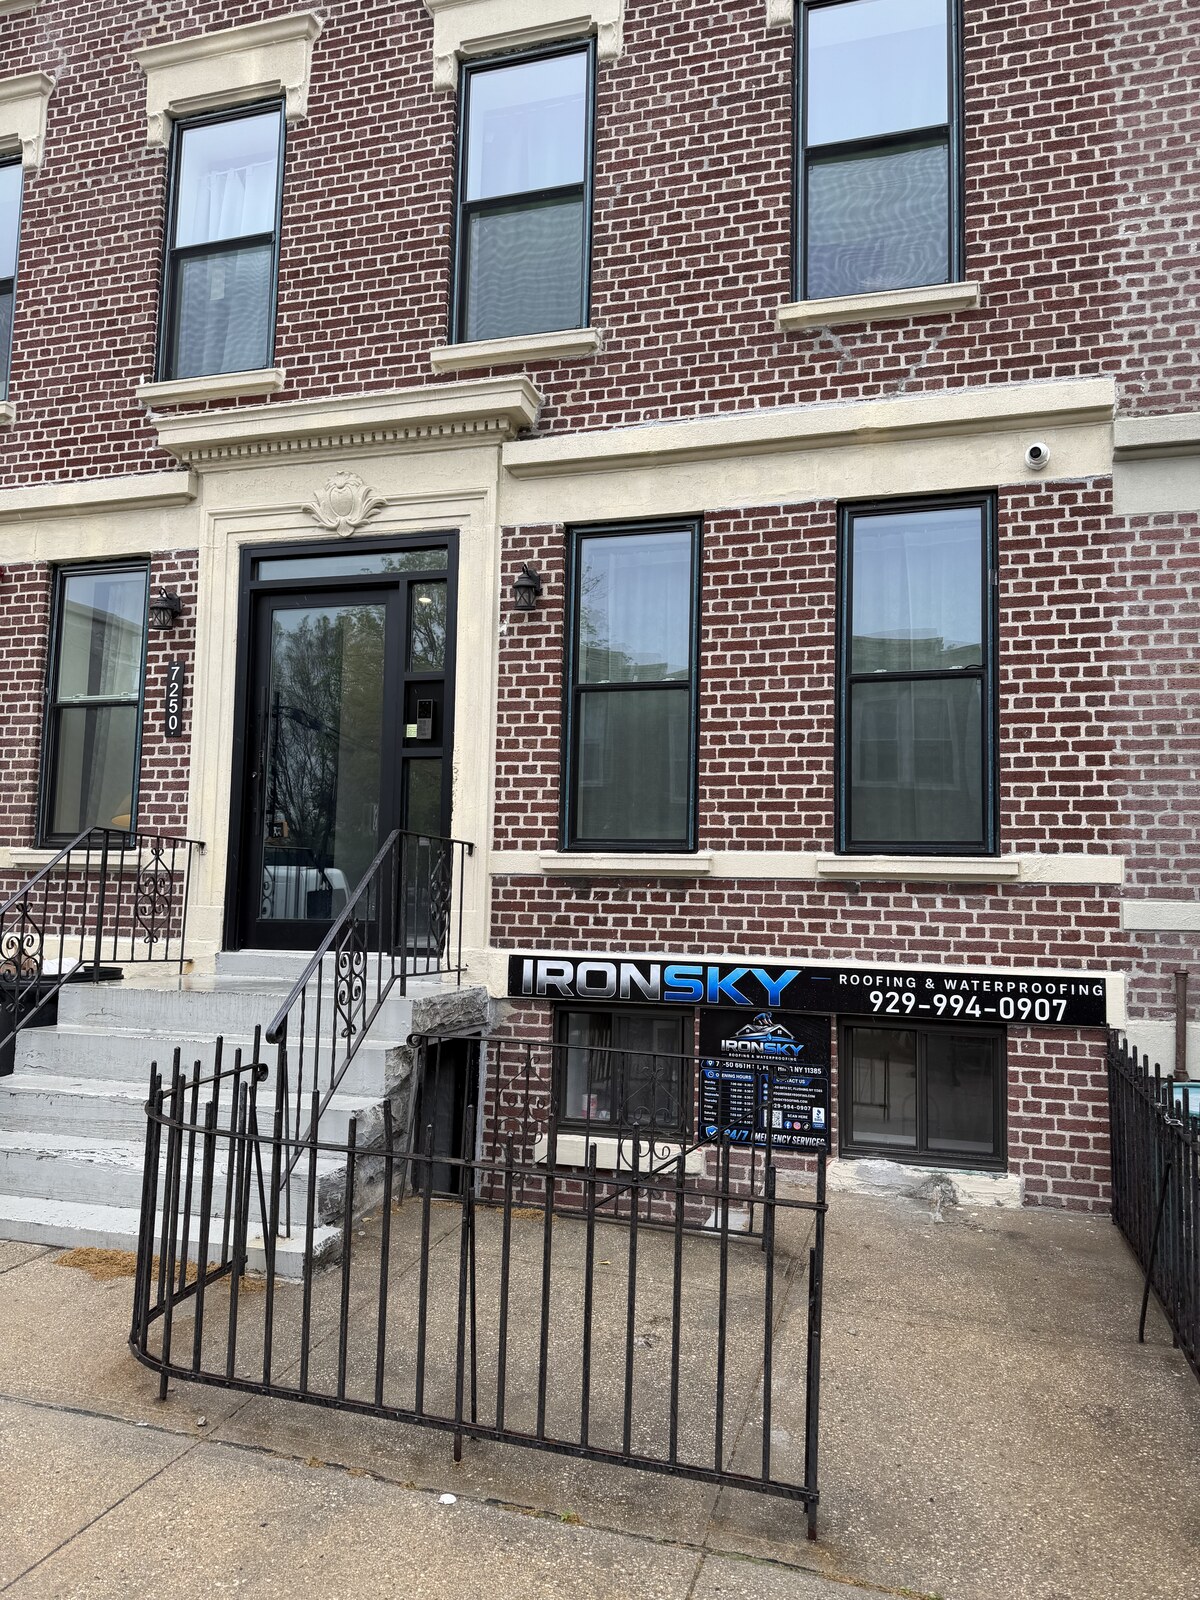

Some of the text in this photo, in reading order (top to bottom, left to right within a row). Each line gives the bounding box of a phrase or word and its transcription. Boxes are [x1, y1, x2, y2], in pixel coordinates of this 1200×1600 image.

[168, 666, 181, 730] 7250
[522, 959, 802, 1007] IRONSKY
[839, 974, 1104, 997] ROOFING & WATERPROOFING
[869, 990, 1068, 1022] 929-994-0907
[721, 1039, 805, 1057] IRONSKY
[715, 1060, 734, 1068] 7-50
[773, 1103, 812, 1111] 29-994-0907
[750, 1131, 792, 1144] MEENCY
